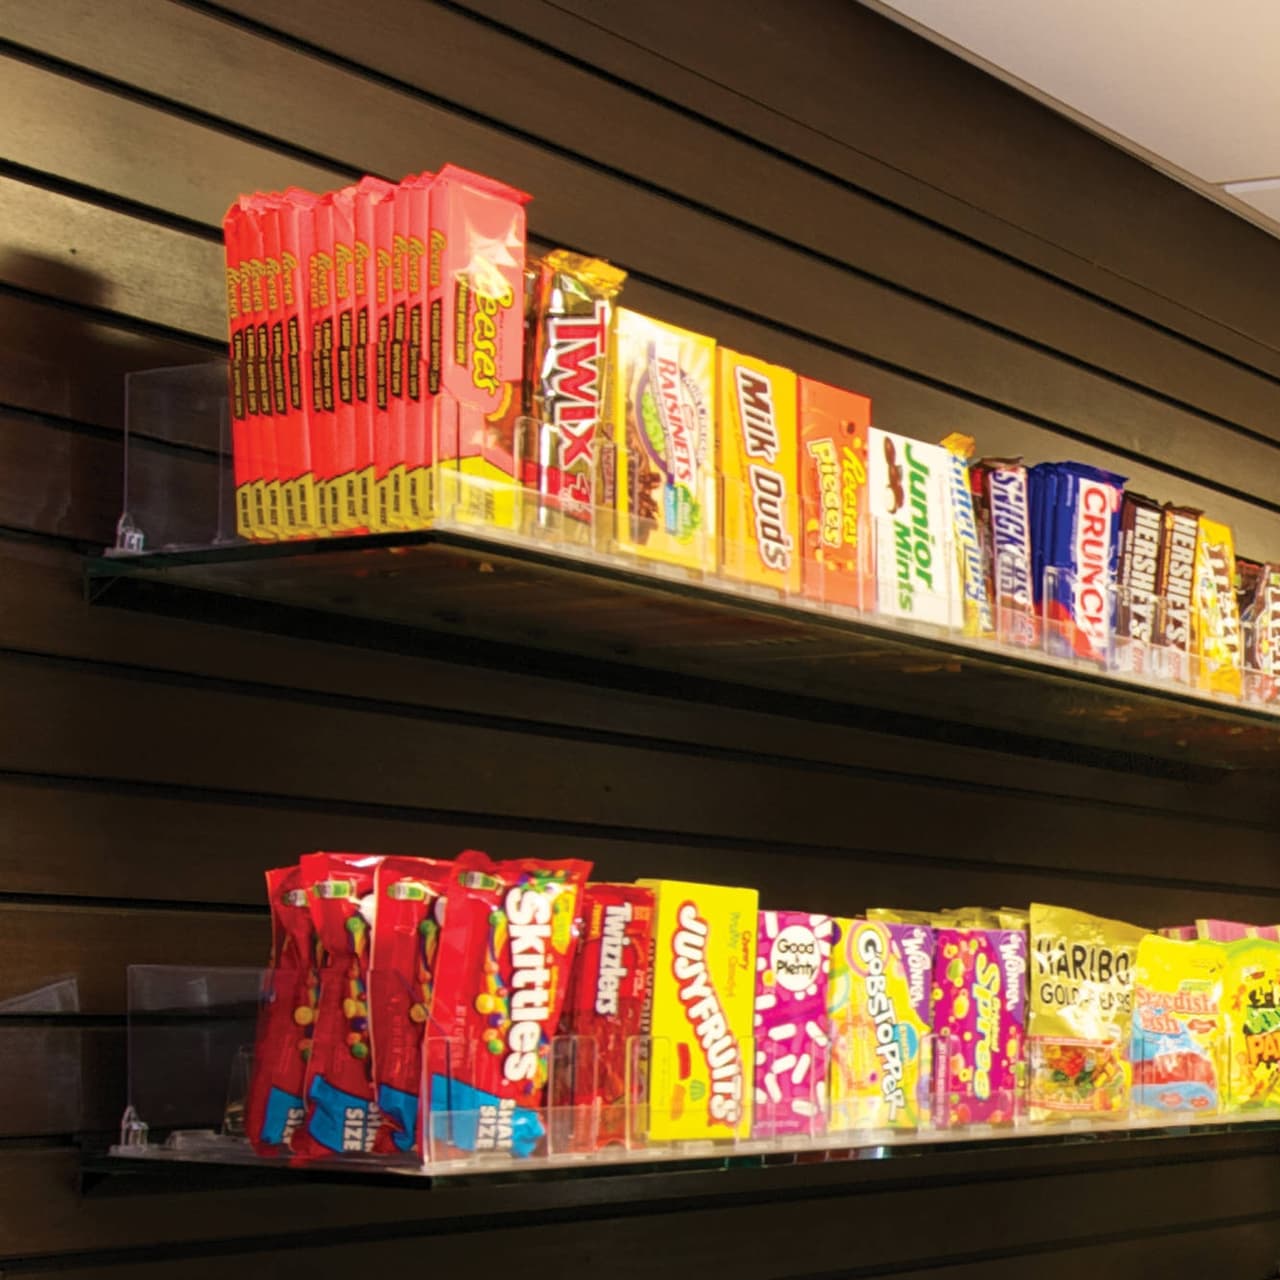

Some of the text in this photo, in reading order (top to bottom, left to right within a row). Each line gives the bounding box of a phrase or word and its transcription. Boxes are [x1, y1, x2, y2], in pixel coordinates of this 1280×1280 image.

[549, 301, 612, 471] TWIX
[657, 356, 694, 483] RAISINETS
[737, 368, 779, 462] Milk
[895, 520, 914, 612] Mints
[904, 442, 934, 590] Junior
[1129, 507, 1162, 645] HERSHEY'S
[1166, 513, 1199, 646] HERSHEY'S
[504, 887, 554, 1082] Skittles
[594, 902, 632, 1017] Twizzlers
[776, 960, 817, 979] Plenty
[777, 937, 815, 955] Good
[1037, 938, 1131, 986] HARIBO
[673, 904, 743, 1123] JUJYFRUITS
[972, 952, 1000, 1101] Spree
[343, 1107, 362, 1152] SIZE
[476, 1105, 497, 1151] SIZE
